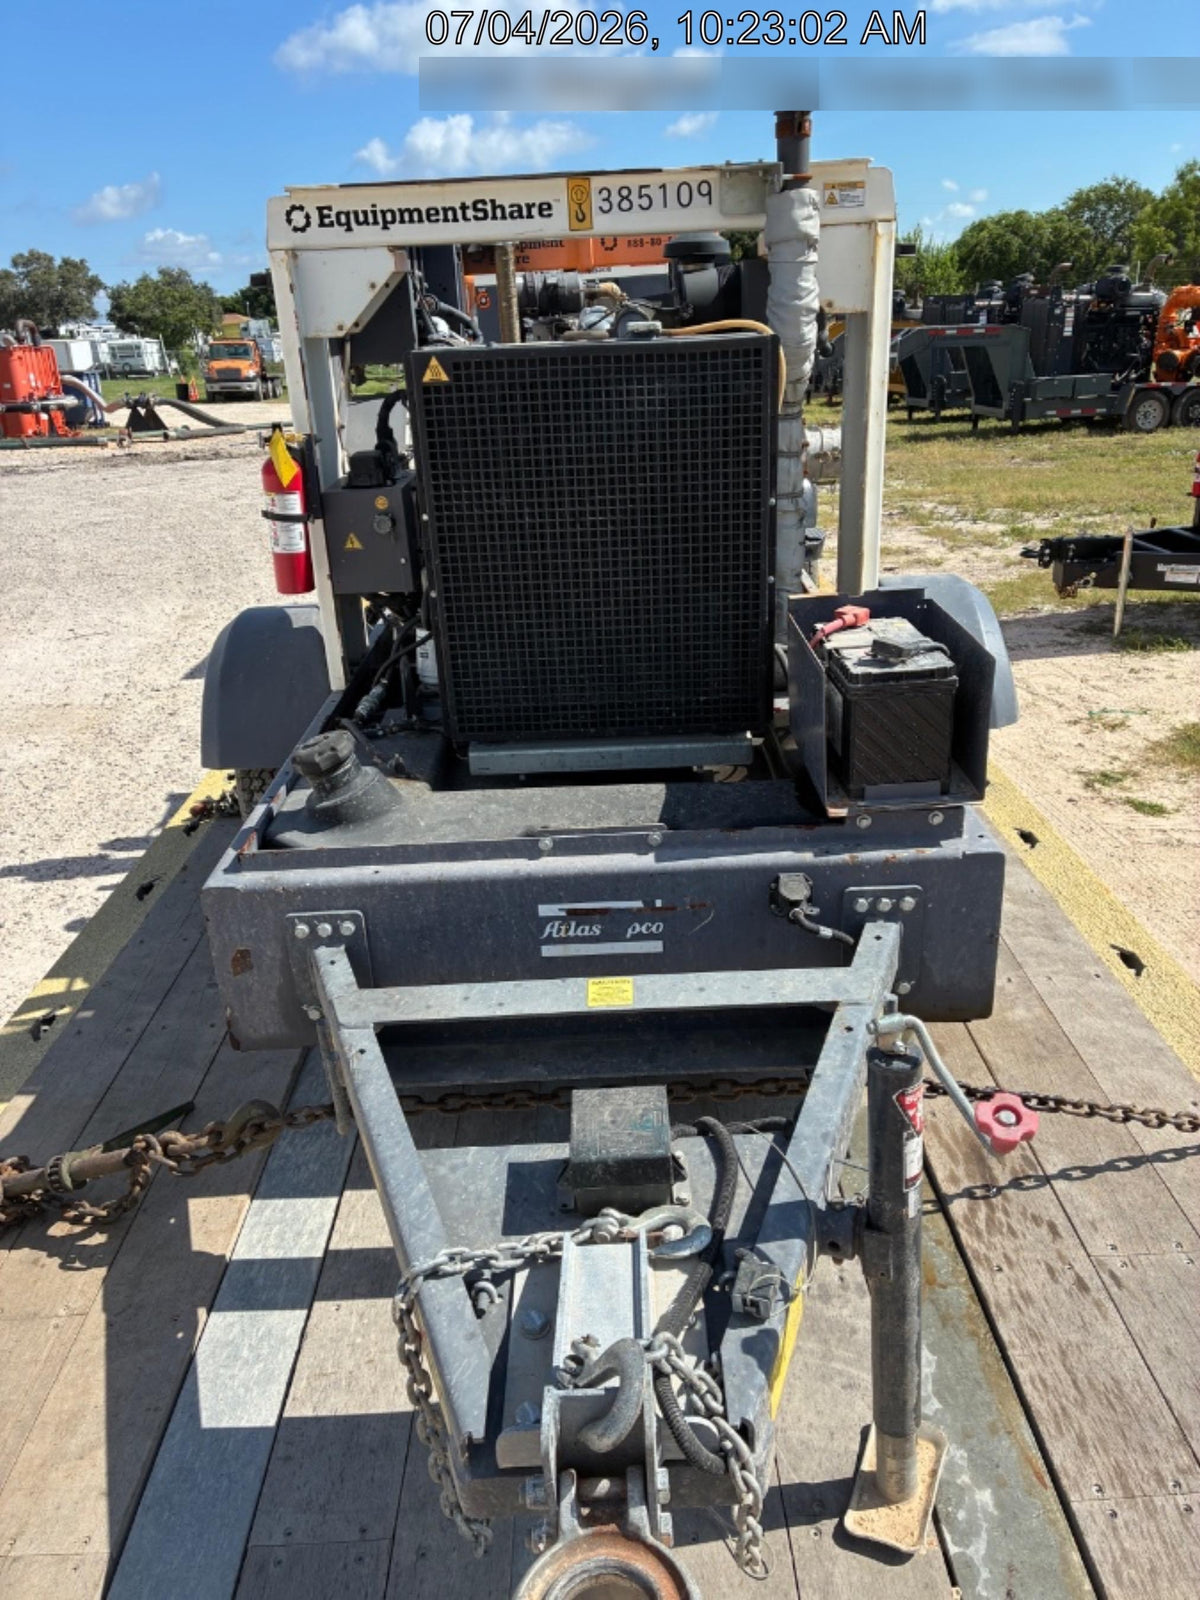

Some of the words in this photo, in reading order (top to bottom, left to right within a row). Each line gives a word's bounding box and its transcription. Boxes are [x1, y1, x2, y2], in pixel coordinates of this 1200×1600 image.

[597, 179, 713, 214] 385109
[316, 198, 553, 232] EquipmentShare
[539, 920, 602, 939] Atlas
[626, 921, 664, 939] pco
